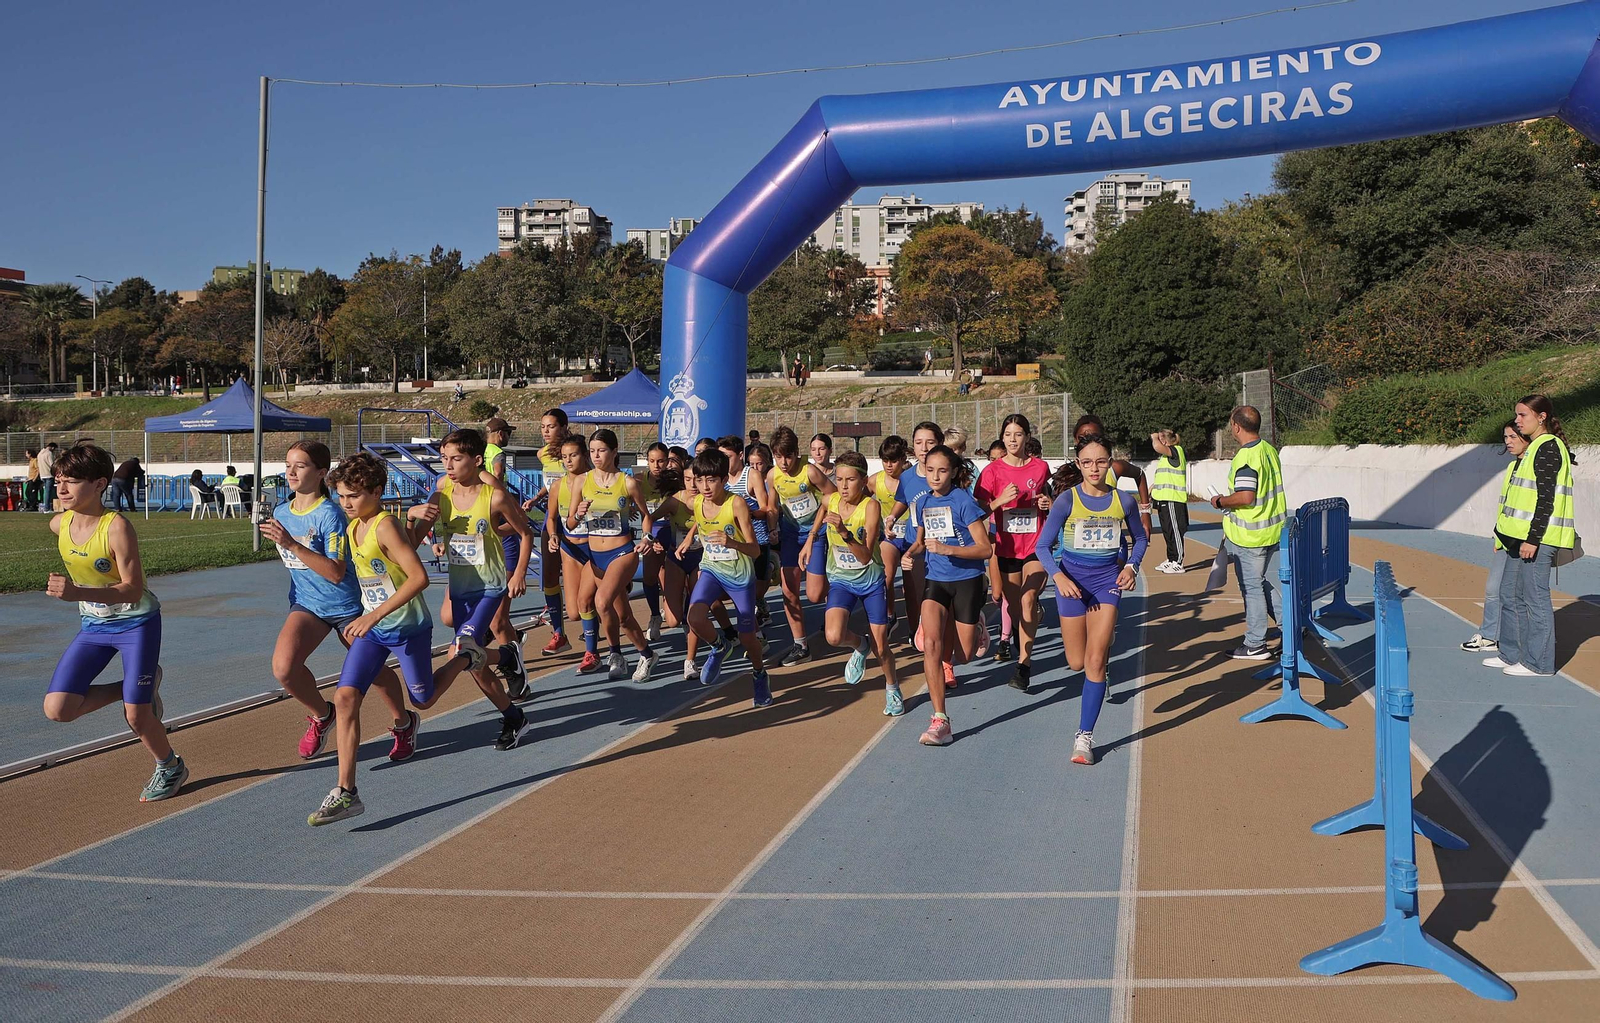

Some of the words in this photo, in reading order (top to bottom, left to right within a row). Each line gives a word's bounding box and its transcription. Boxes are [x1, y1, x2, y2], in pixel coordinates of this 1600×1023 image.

[998, 41, 1382, 108] AYUNTAMIENTO
[1026, 119, 1073, 149] DE
[1086, 81, 1354, 143] ALGECIRAS
[576, 410, 652, 418] info@dorsalchip.es
[792, 499, 811, 512] 437
[593, 519, 615, 529] 398
[925, 518, 946, 530] 365
[1008, 516, 1031, 526] 430
[894, 525, 906, 533] 19
[1082, 529, 1113, 541] 314
[281, 546, 297, 559] 33
[450, 544, 477, 557] 325
[705, 543, 730, 554] 432
[839, 553, 857, 563] 48
[364, 587, 389, 603] 93
